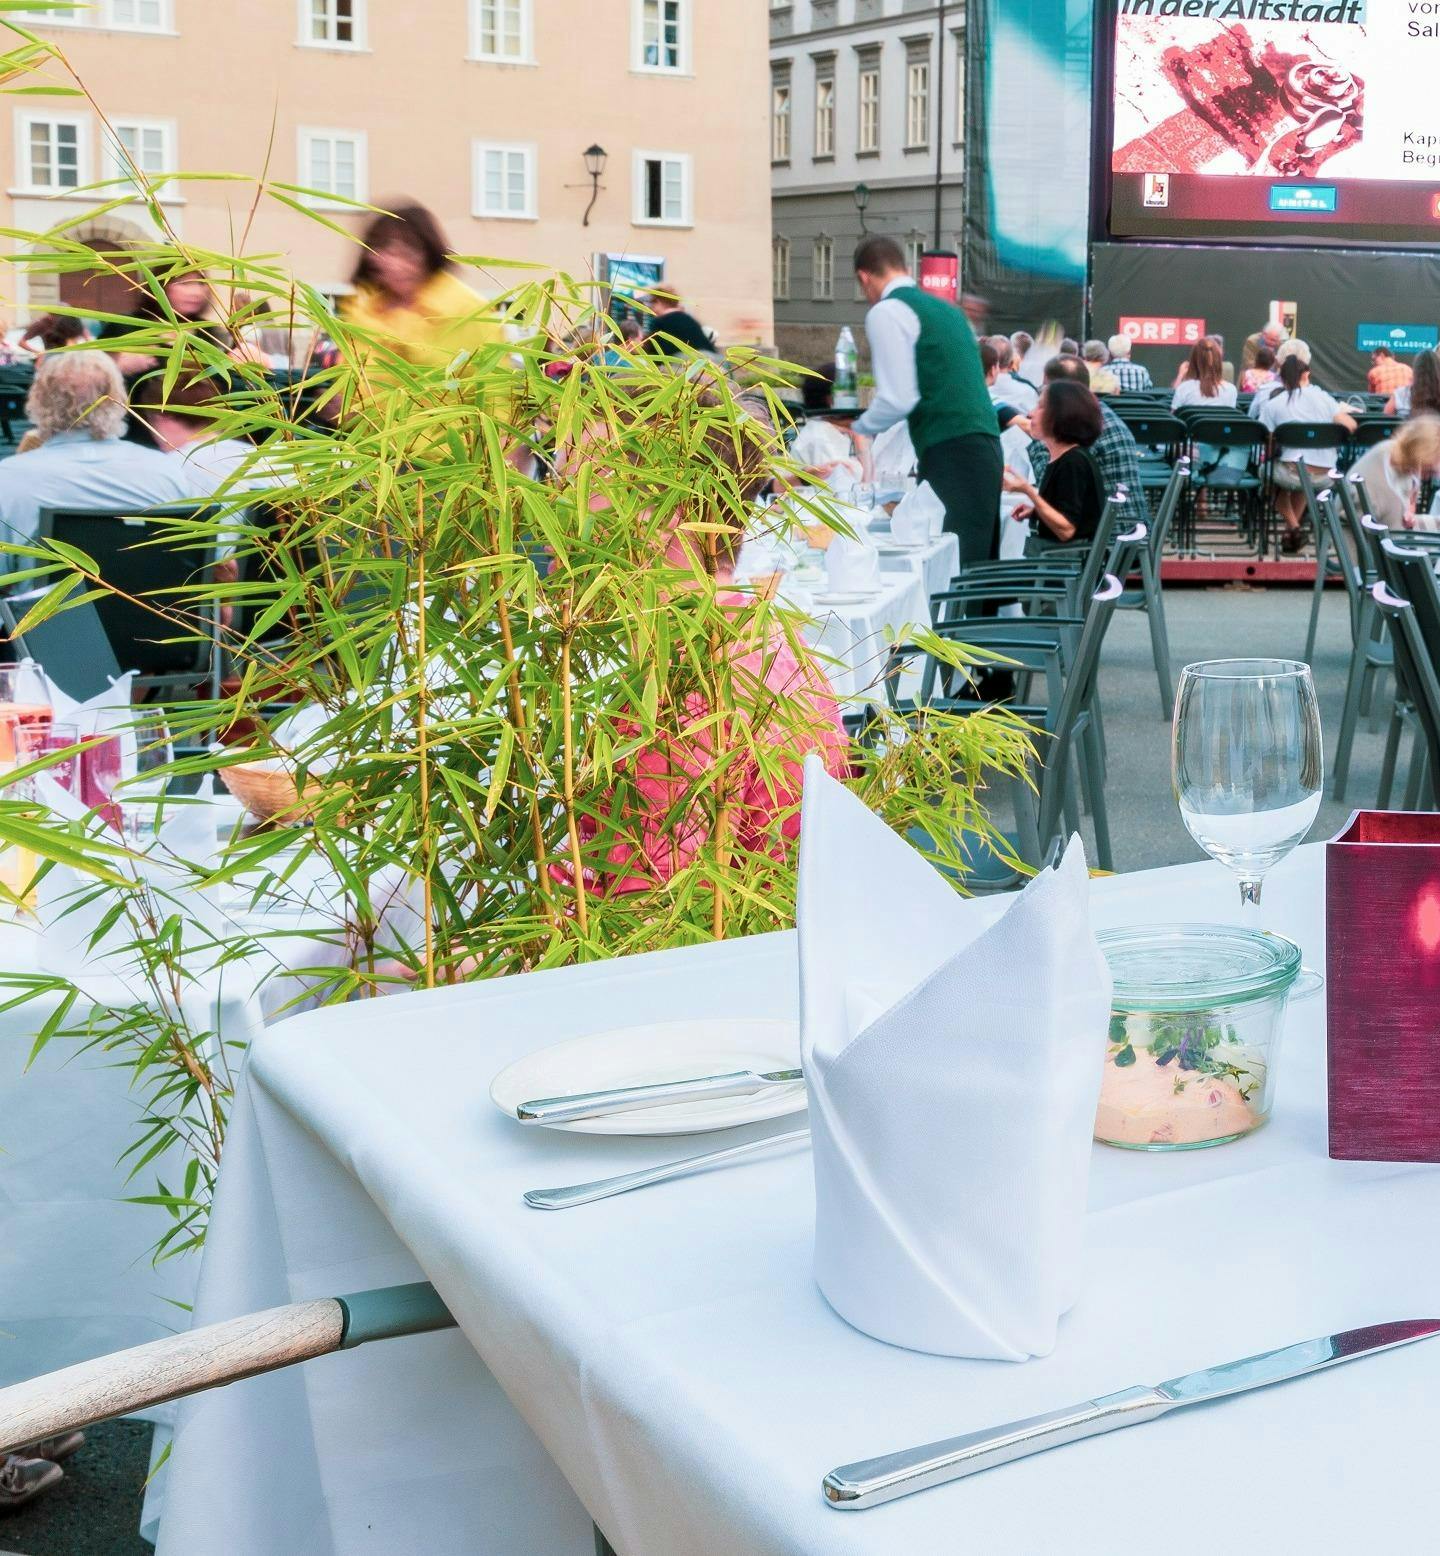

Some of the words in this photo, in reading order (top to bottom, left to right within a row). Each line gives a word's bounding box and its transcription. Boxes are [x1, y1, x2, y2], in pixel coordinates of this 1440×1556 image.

[1121, 0, 1150, 15] in
[1159, 0, 1217, 18] der
[1218, 0, 1363, 24] Altstadt
[1123, 321, 1177, 340] ORF
[1184, 323, 1200, 341] S
[1362, 339, 1391, 347] UNITEL
